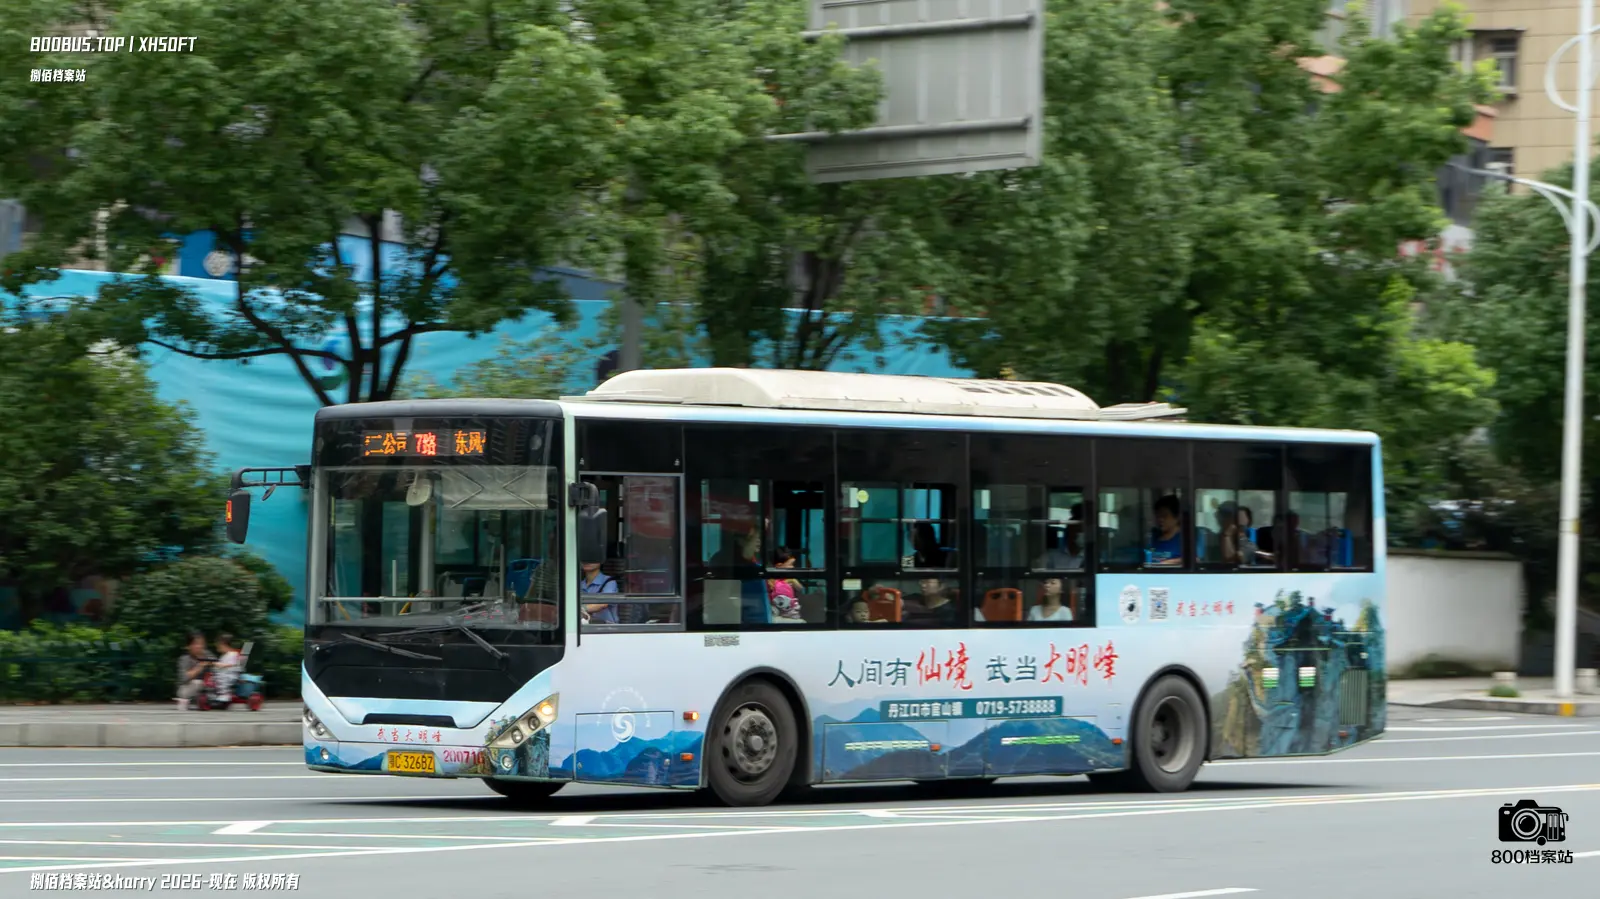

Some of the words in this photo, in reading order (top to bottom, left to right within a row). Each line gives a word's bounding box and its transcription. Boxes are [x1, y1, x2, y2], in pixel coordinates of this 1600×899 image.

[414, 432, 437, 456] 7路
[454, 430, 487, 455] 东风
[828, 642, 973, 690] 人间有仙境
[985, 641, 1119, 688] 武当大明峰
[377, 726, 442, 743] 武当大明峰
